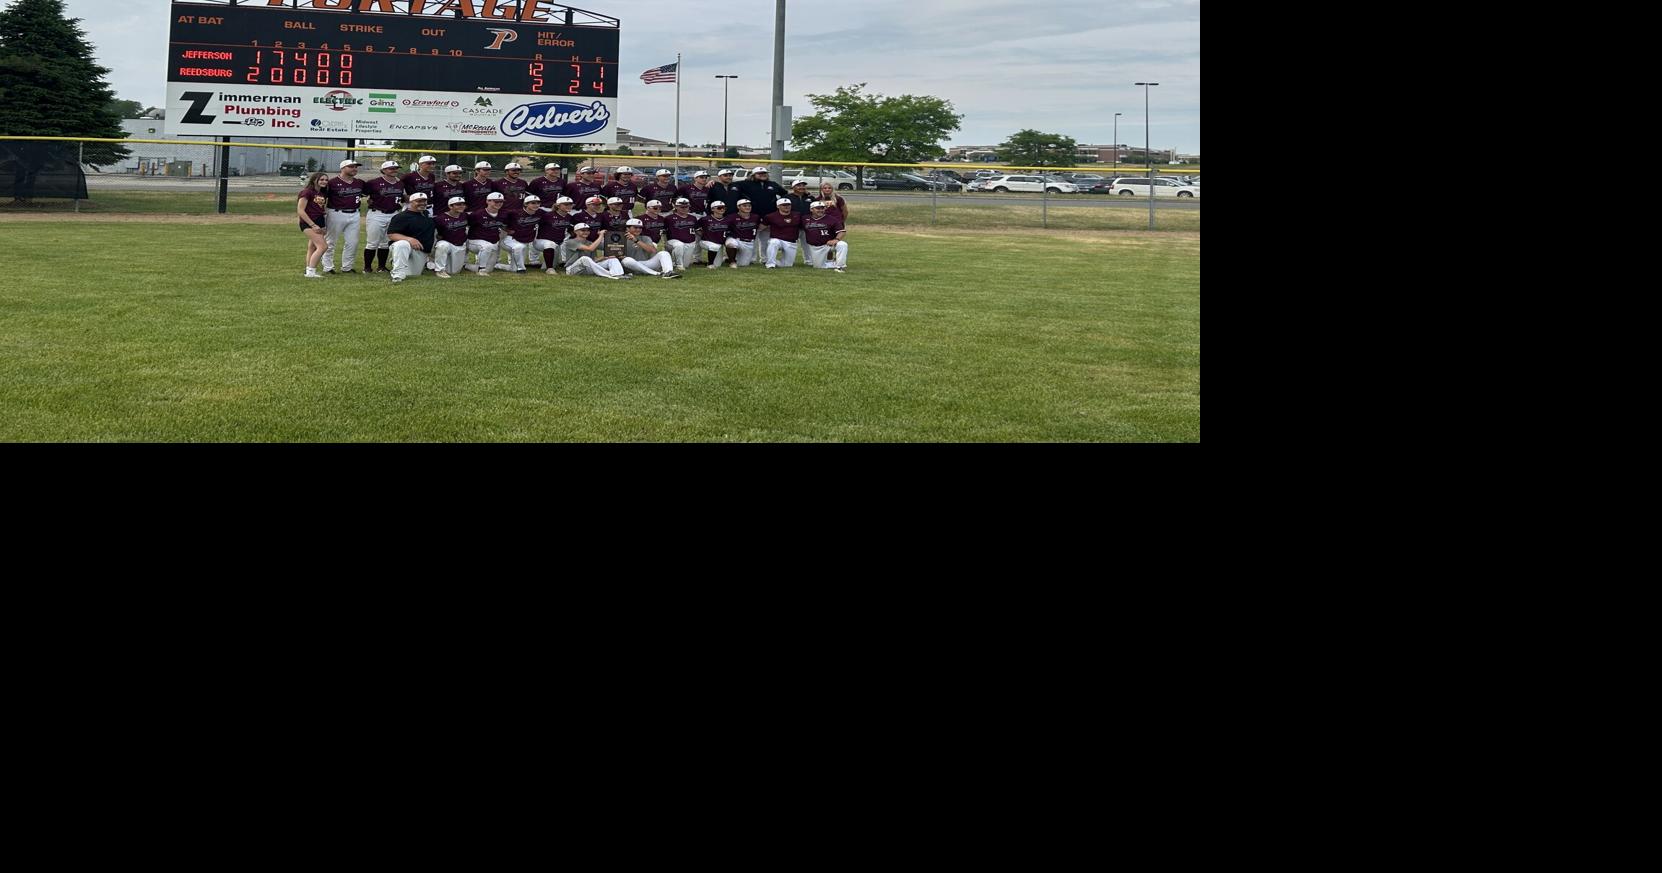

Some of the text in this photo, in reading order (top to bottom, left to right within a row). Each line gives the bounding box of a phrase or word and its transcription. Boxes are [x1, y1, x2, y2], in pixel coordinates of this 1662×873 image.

[267, 0, 549, 22] RTAGE
[178, 15, 224, 25] AT BAT
[284, 20, 316, 30] BALL
[340, 24, 384, 34] STRIKE
[421, 28, 446, 37] OUT
[483, 27, 518, 50] P
[537, 31, 562, 40] HIT/
[537, 38, 576, 47] ERROR
[388, 46, 396, 54] 7
[409, 47, 417, 55] 8
[431, 48, 439, 56] 9
[182, 50, 233, 61] JEFFERSON
[255, 51, 261, 64] 1
[273, 51, 284, 66] 7
[295, 52, 307, 66] 4
[317, 53, 330, 68] 0
[340, 54, 353, 69] 0
[529, 62, 544, 77] 12
[571, 64, 580, 78] 7
[179, 66, 604, 94] REEDSBURG 2 0 0 0 0 2 2 4
[313, 97, 364, 105] ELECTRIC
[412, 99, 450, 107] Crawford
[224, 105, 301, 118] Plumbing
[271, 118, 300, 128] Inc.
[501, 101, 610, 137] Culver's
